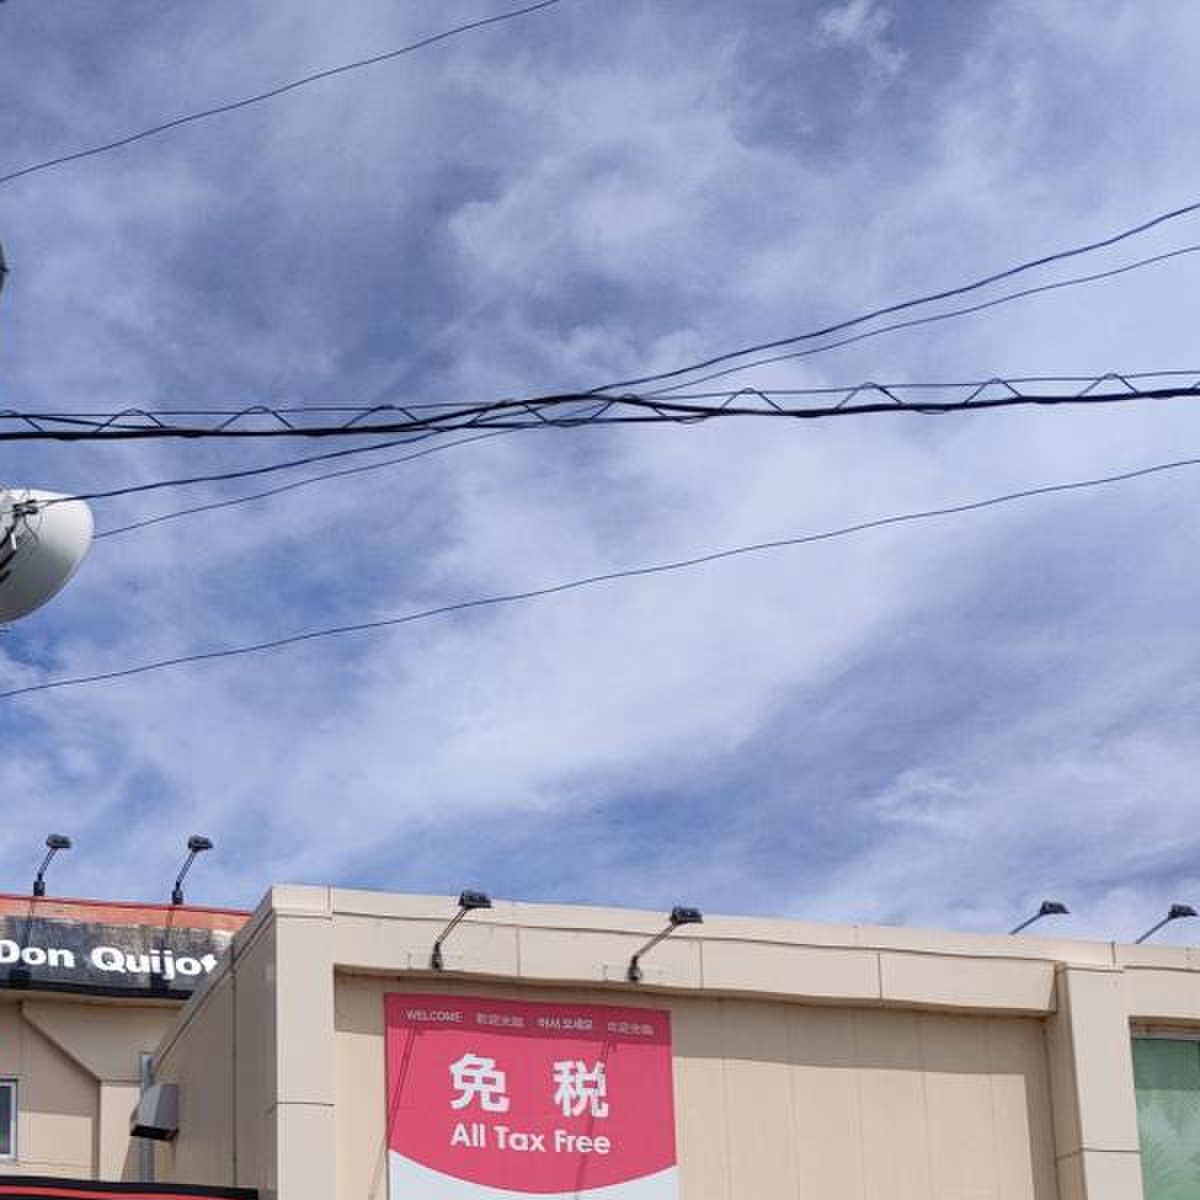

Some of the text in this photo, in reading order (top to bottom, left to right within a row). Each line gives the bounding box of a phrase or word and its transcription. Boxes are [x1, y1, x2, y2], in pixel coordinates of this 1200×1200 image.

[90, 945, 219, 981] Quijot
[406, 1009, 463, 1023] WELCOME
[449, 1053, 609, 1118] 免税
[451, 1123, 611, 1155] All Tax Free
